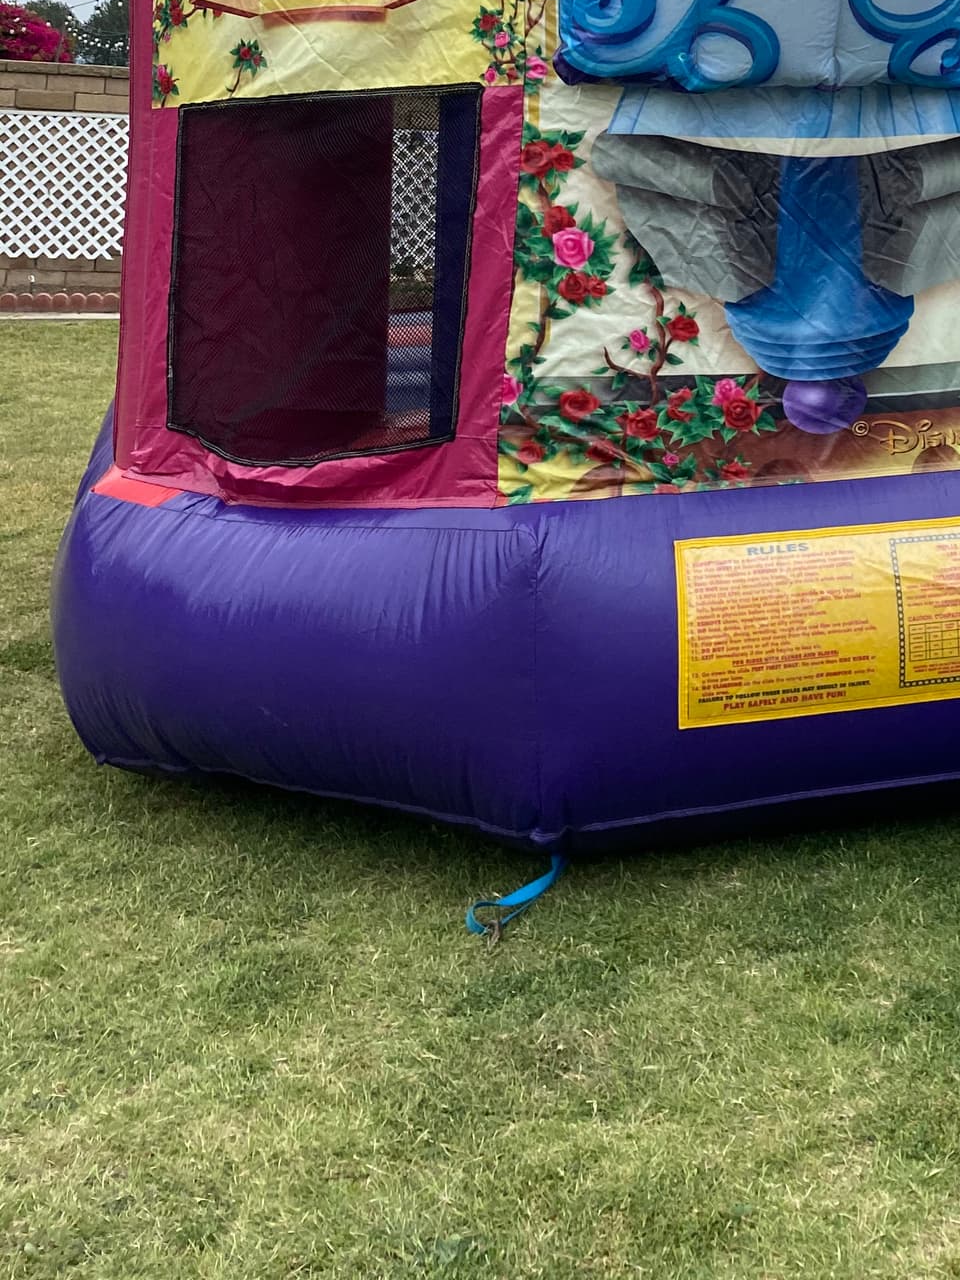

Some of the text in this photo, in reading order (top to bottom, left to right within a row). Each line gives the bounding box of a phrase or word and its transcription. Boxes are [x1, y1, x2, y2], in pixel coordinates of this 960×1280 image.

[747, 542, 810, 556] RULES
[698, 696, 724, 704] FAILURE
[735, 692, 761, 700] FOLLOW
[762, 689, 780, 697] THESE
[781, 687, 801, 695] RULES
[723, 690, 847, 711] PLAY SAFELY AND HAVE FUN!
